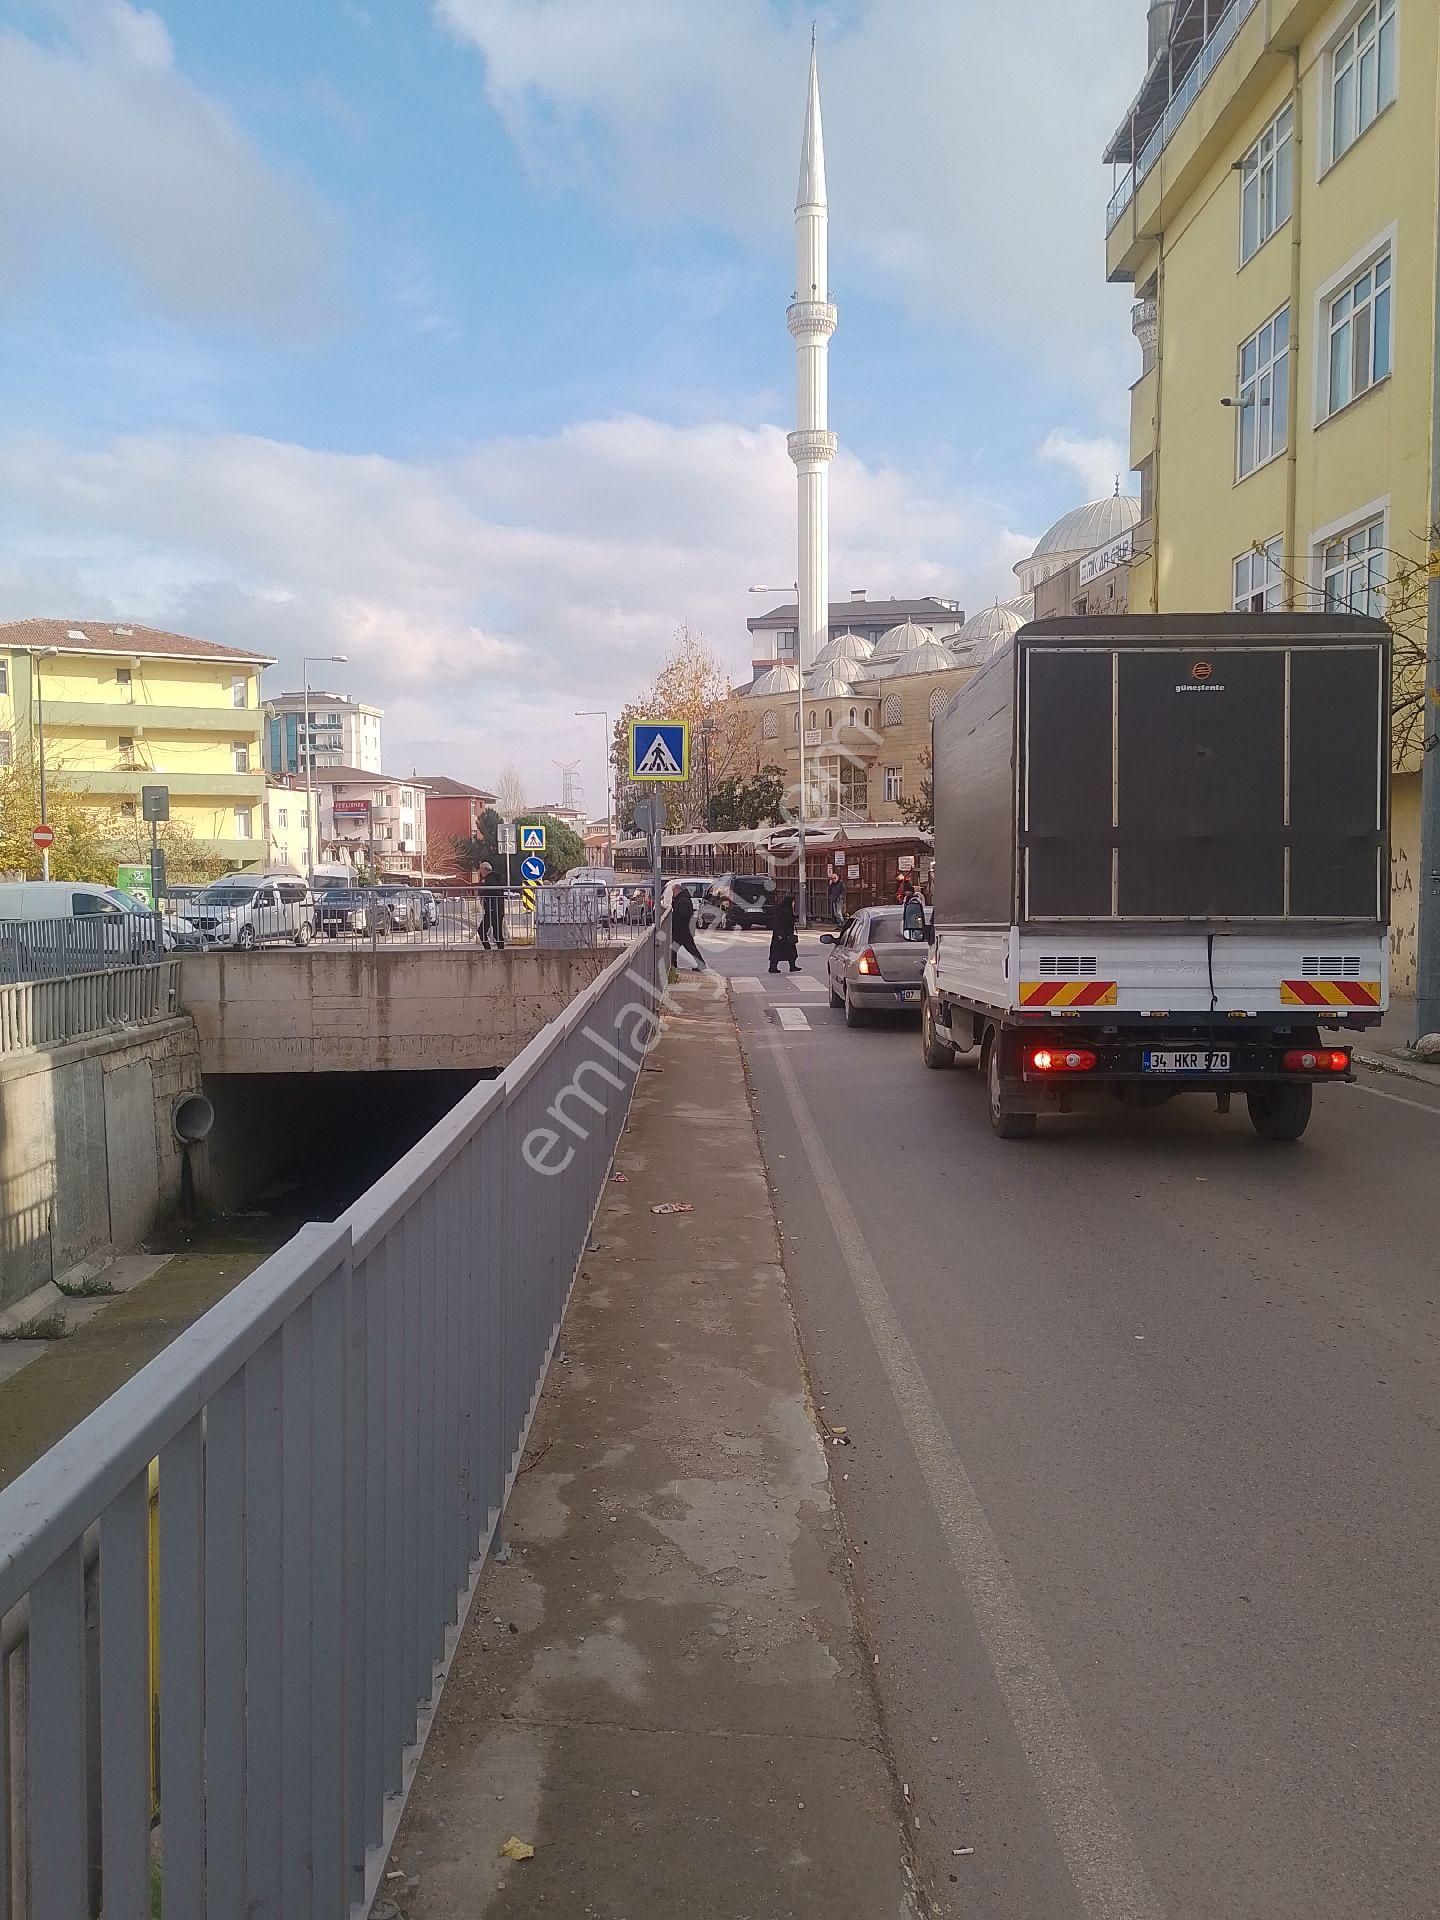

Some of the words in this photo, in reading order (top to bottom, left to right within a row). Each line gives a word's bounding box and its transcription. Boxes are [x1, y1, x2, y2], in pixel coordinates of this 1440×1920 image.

[905, 990, 915, 999] 07
[1152, 1054, 1167, 1067] 34
[1174, 1054, 1198, 1067] HKR
